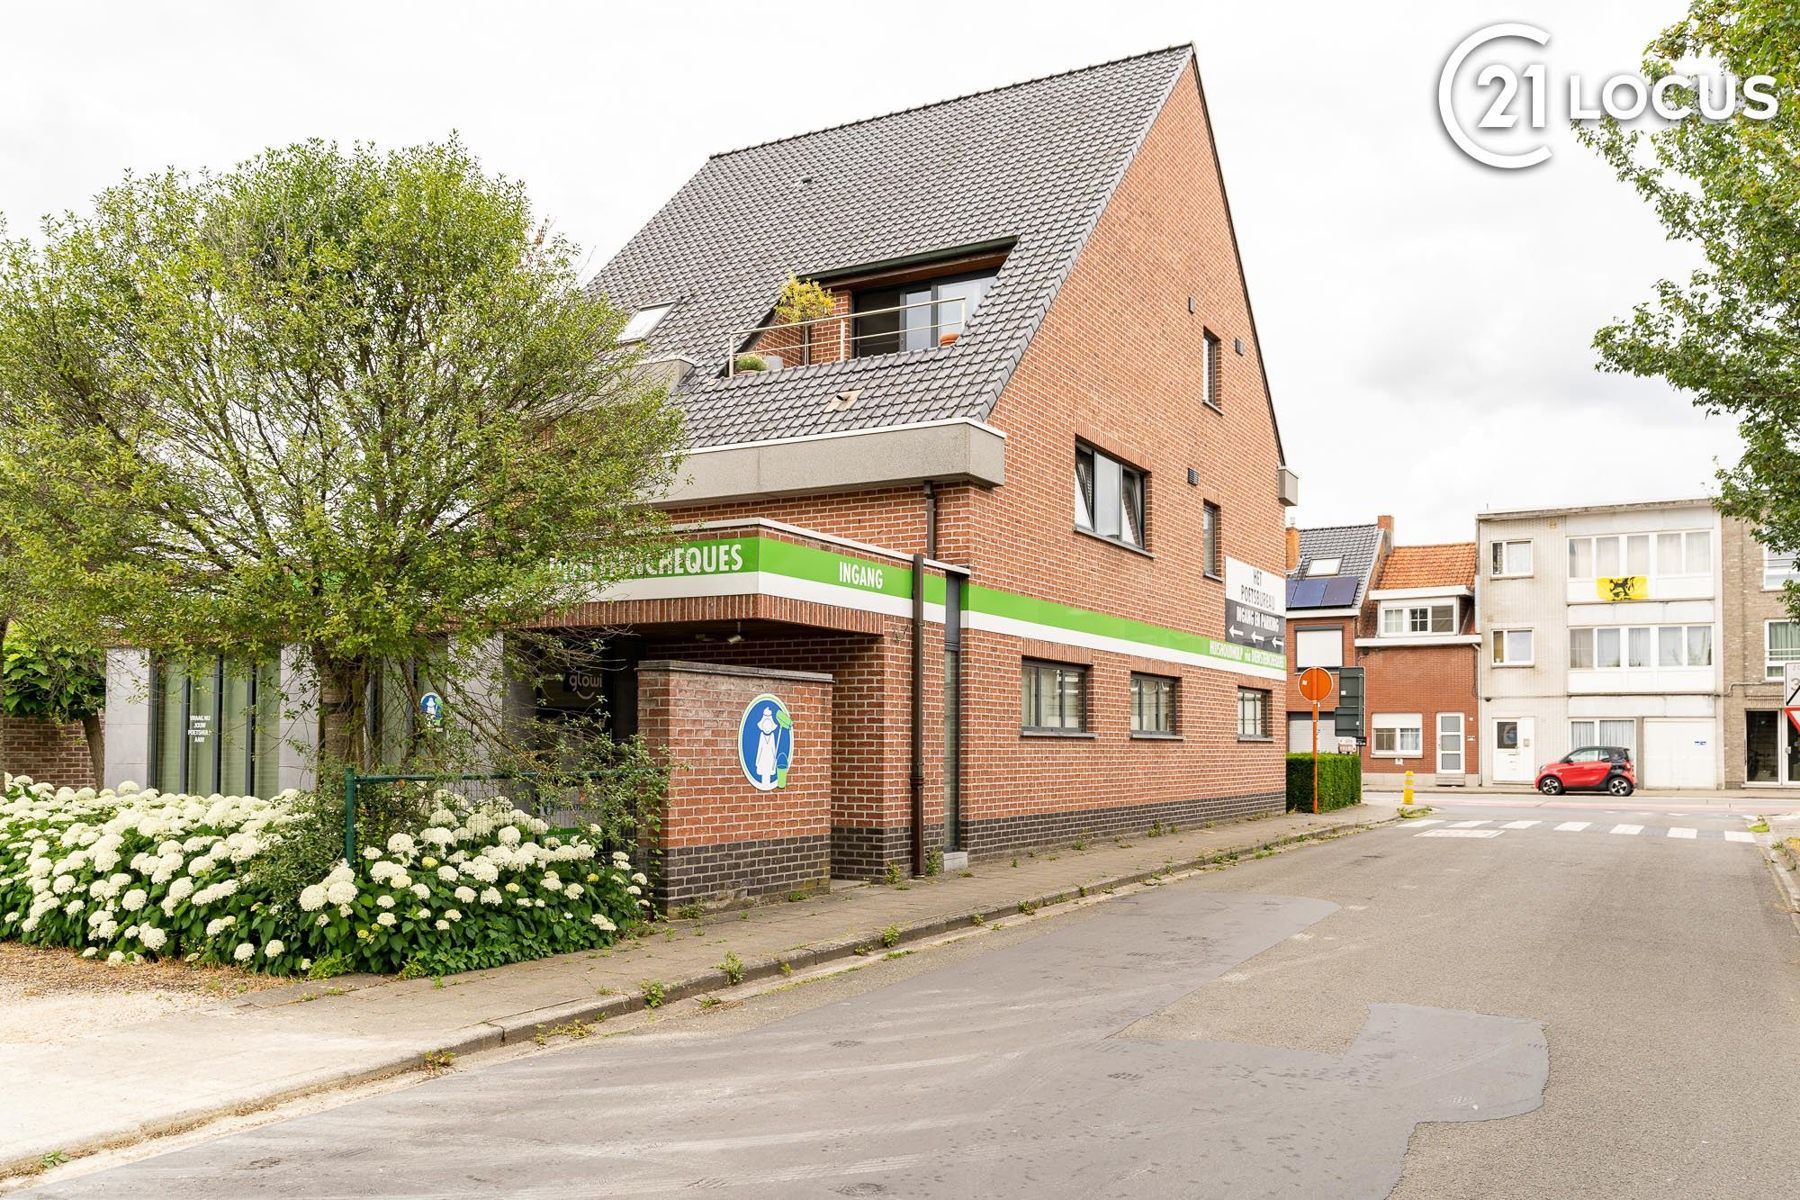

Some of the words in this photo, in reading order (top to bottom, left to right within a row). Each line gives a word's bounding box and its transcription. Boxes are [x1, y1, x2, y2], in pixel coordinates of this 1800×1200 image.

[839, 562, 884, 589] INGANG
[1253, 569, 1262, 586] HET
[1241, 585, 1275, 611] POETSBUREAU
[1236, 606, 1254, 626] INGANG
[1254, 611, 1261, 627] EN
[569, 671, 602, 691] glowi
